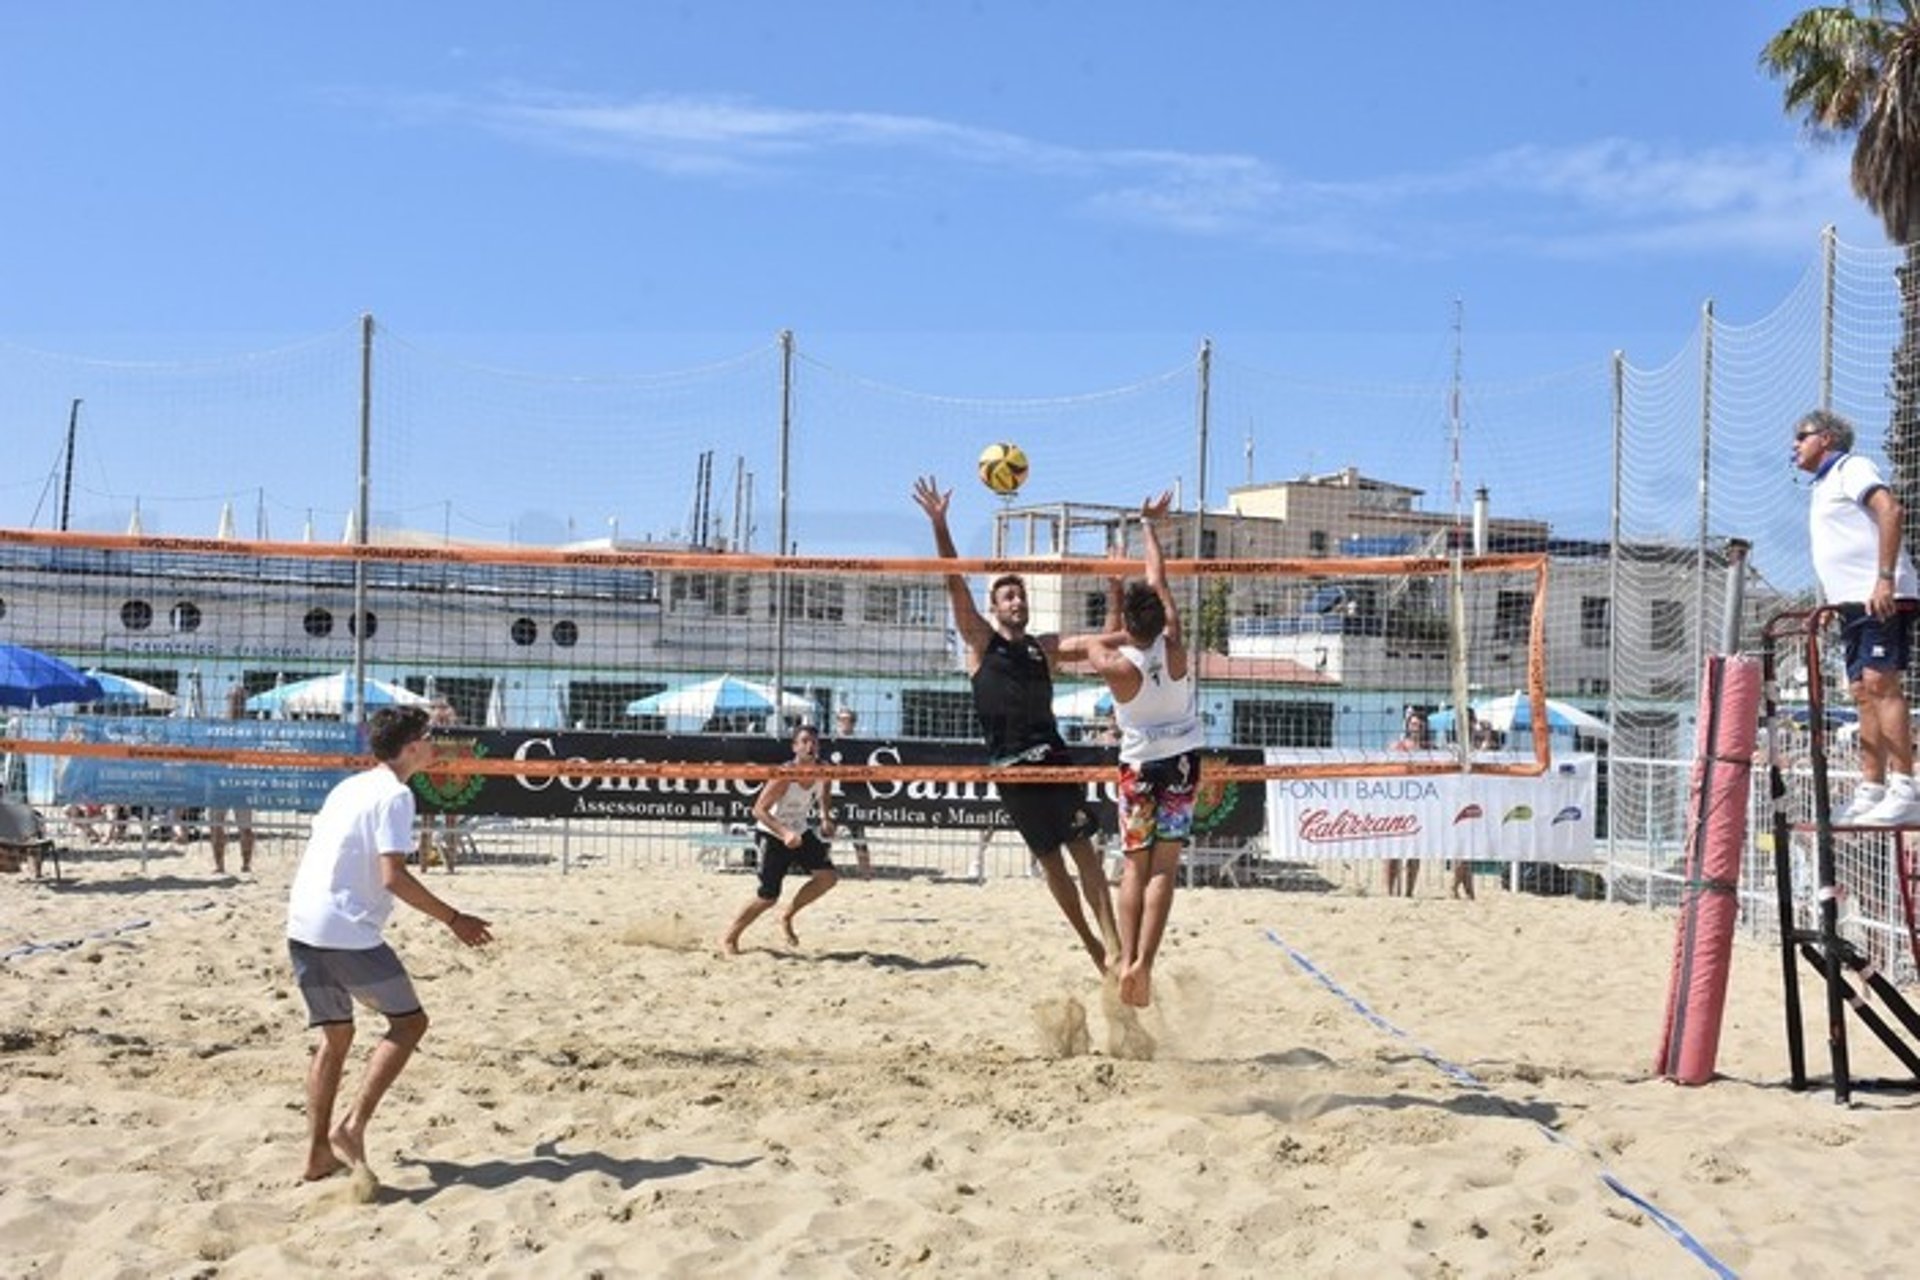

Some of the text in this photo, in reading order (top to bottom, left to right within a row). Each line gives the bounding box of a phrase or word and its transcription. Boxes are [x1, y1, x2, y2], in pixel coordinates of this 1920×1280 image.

[513, 737, 765, 796] Comune
[1279, 780, 1439, 801] FONTI BAUDA
[574, 796, 686, 816] Assessorato
[690, 800, 725, 817] alla
[846, 803, 926, 823] Turistica
[932, 811, 942, 824] e
